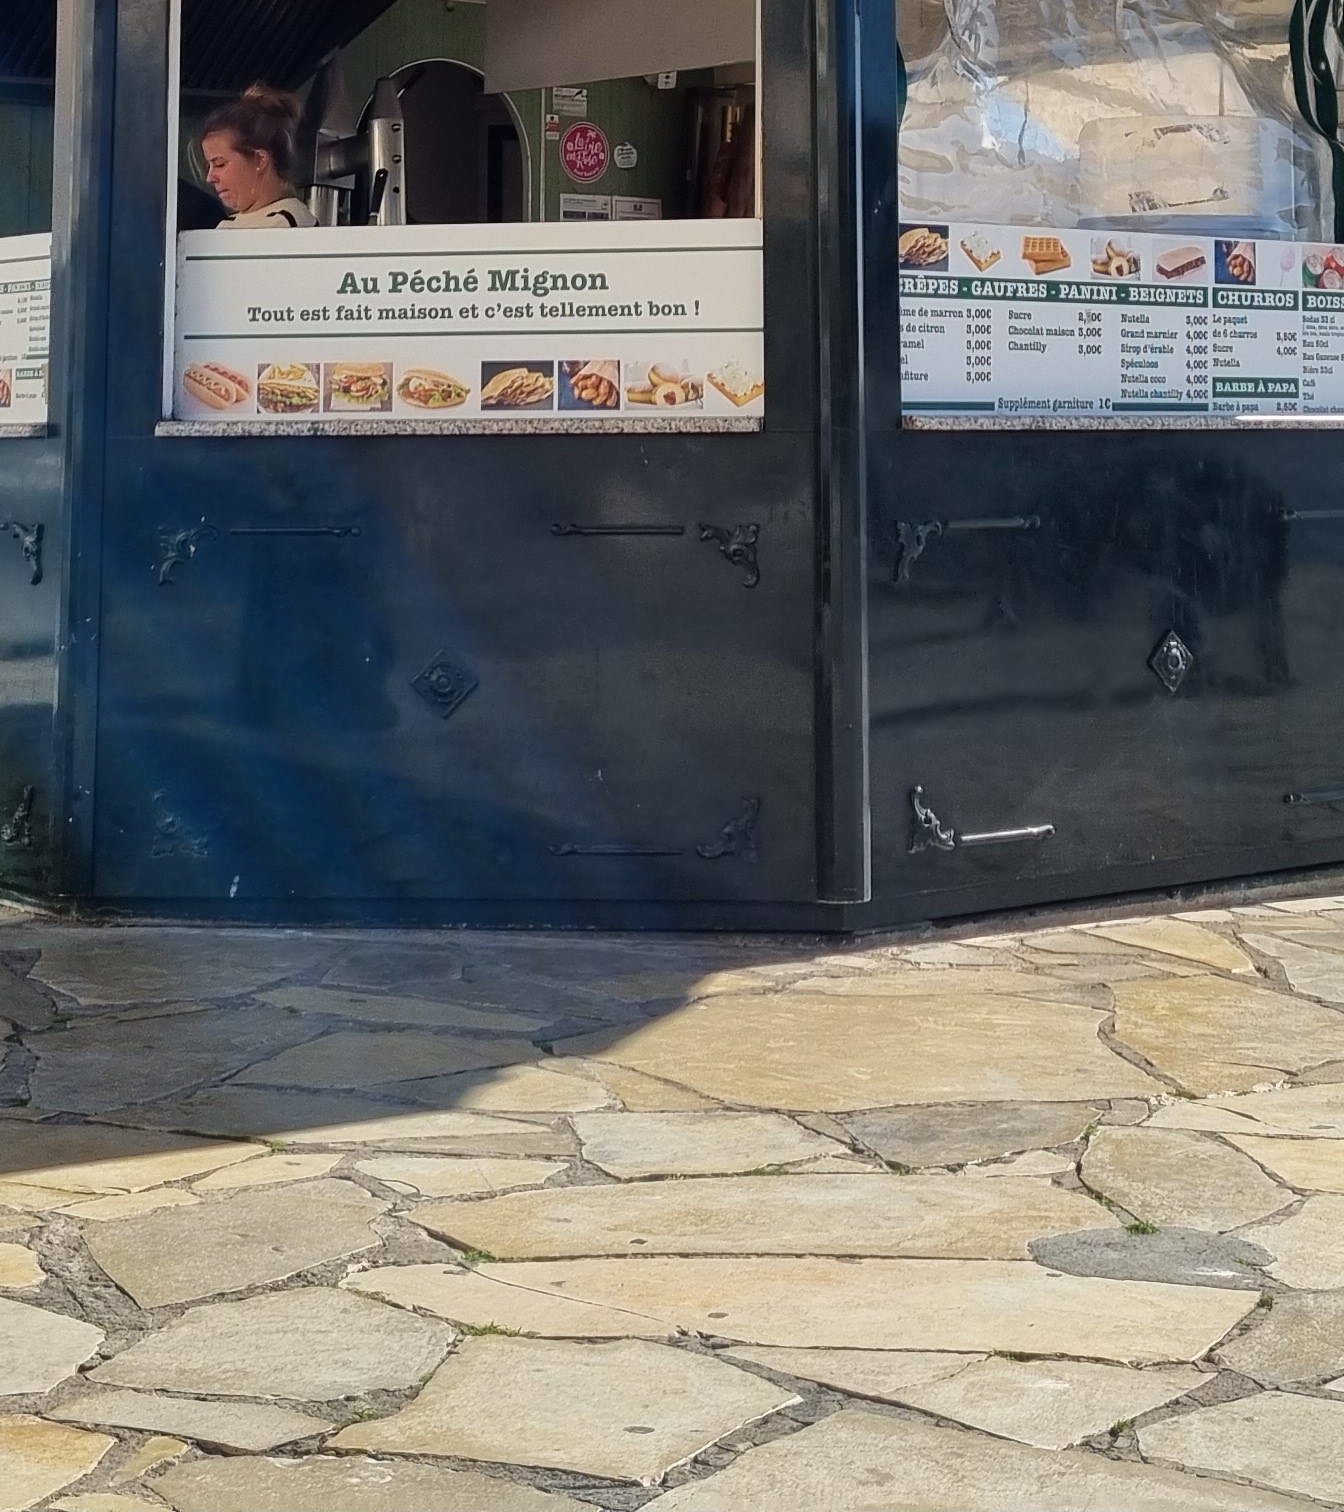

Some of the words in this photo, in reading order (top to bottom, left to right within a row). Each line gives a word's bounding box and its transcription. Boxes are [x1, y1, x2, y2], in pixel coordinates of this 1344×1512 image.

[336, 272, 380, 295] Au
[388, 268, 479, 293] Péché
[487, 268, 609, 298] Mignon
[971, 281, 1047, 297] GAUFRES
[1059, 284, 1118, 300] PANINI
[1129, 287, 1204, 303] BEIGNETS
[1217, 291, 1295, 307] CHURROS
[248, 306, 294, 322] Tout
[300, 307, 330, 321] est
[335, 305, 372, 321] fait
[377, 304, 453, 321] maison
[459, 304, 479, 320] et
[484, 303, 534, 319] c'est
[539, 302, 643, 318] tellement
[648, 301, 687, 317] bon
[918, 306, 928, 317] de
[966, 308, 992, 321] 3,00€
[1008, 310, 1032, 320] Sucre
[1078, 311, 1102, 324] 2,0€
[1121, 314, 1150, 324] Nutella
[1213, 314, 1221, 324] Le
[906, 323, 916, 333] de
[918, 323, 945, 334] citron
[966, 324, 992, 337] 3,00€
[1008, 325, 1044, 336] Chocolat
[1046, 327, 1075, 337] maison
[1078, 327, 1102, 340] 3,00€
[1213, 329, 1221, 338] de
[1185, 331, 1208, 343] 4,00€
[966, 340, 992, 352] 3,00€
[1008, 341, 1047, 353] Chantilly
[1078, 344, 1102, 357] 3,00€
[1121, 343, 1141, 355] Sirop
[1185, 345, 1208, 357] 4,00€
[966, 356, 992, 368] 3,00€
[1185, 360, 1208, 372] 4,00€
[966, 371, 992, 384] 3,00€
[1121, 374, 1148, 384] Nutella
[1150, 376, 1166, 384] coco
[1185, 375, 1208, 387] 4,00€
[1215, 382, 1254, 392] BARBE
[1268, 382, 1297, 393] PAPA
[1121, 389, 1148, 399] Nutella
[1185, 389, 1208, 401] 4,00€
[998, 396, 1051, 412] Supplément
[1052, 397, 1094, 412] garniture
